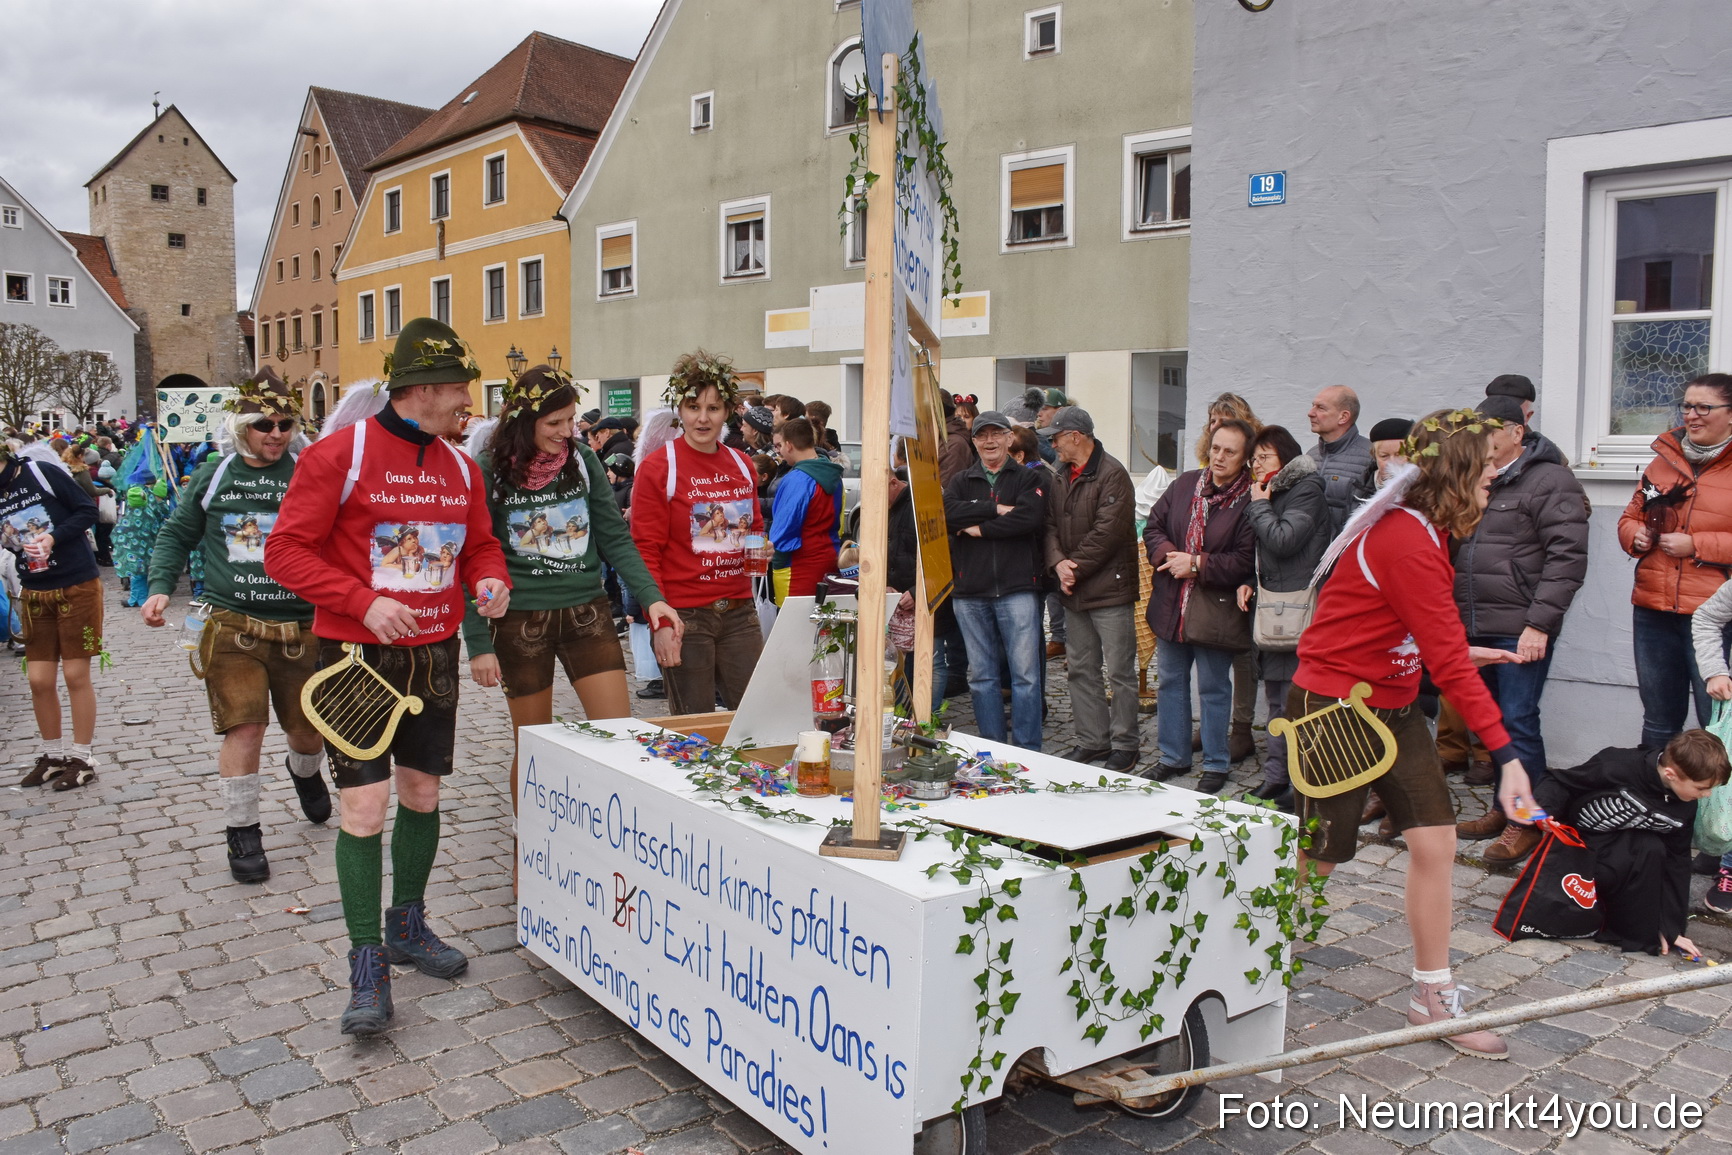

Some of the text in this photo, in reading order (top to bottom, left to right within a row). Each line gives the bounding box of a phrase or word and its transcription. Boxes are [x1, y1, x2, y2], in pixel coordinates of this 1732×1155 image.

[1260, 175, 1275, 192] 19
[180, 421, 210, 436] regiert
[259, 475, 275, 486] des
[278, 479, 288, 488] is
[385, 470, 447, 487] Oans des is
[690, 473, 730, 487] Oans des
[220, 490, 242, 502] scho
[369, 490, 397, 504] scho
[400, 493, 437, 505] immer
[504, 492, 528, 506] scho
[705, 489, 731, 499] immer
[702, 557, 714, 567] in
[234, 573, 246, 583] in
[234, 590, 297, 601] as Paradies
[441, 603, 450, 614] is
[523, 754, 891, 990] As gstoine Ortsschild kinnts pfalten
[522, 838, 552, 881] weil
[556, 850, 582, 898] wir
[585, 877, 605, 916] an
[885, 1024, 908, 1100] is
[520, 900, 561, 954] gwies
[580, 925, 640, 1029] Oening
[646, 968, 663, 1029] is
[668, 1007, 692, 1048] as
[704, 1007, 828, 1149] Paradies!
